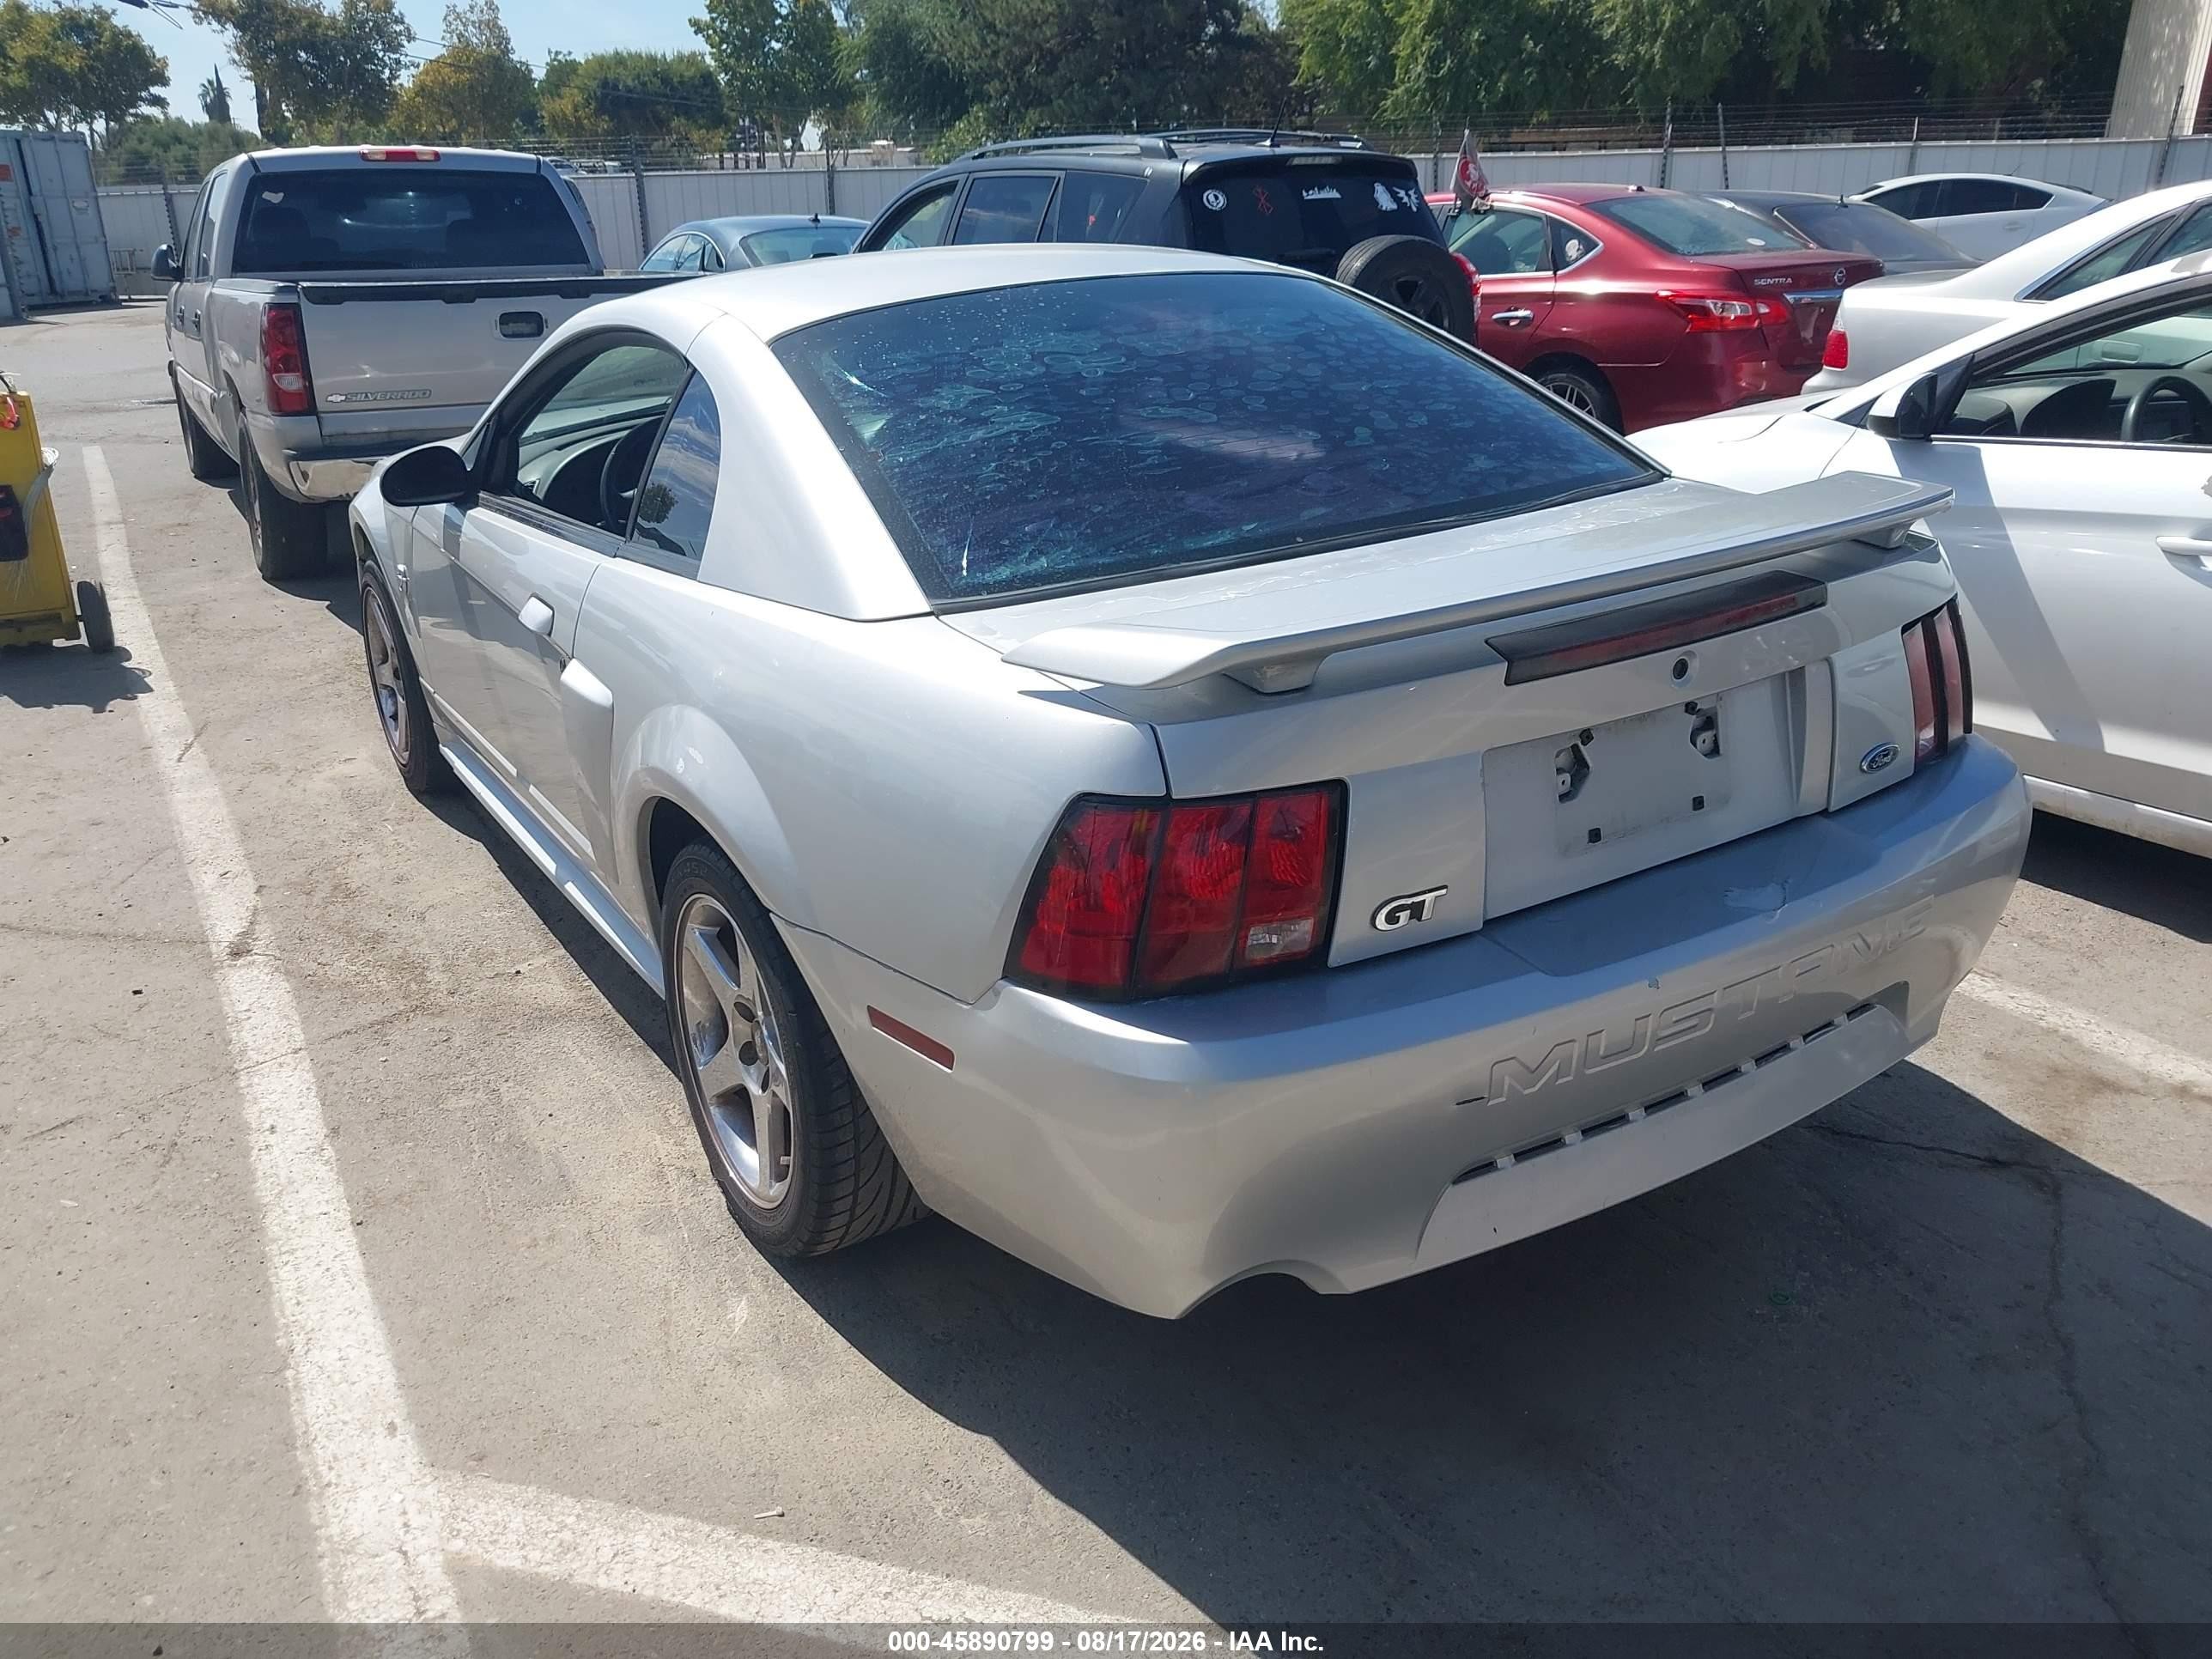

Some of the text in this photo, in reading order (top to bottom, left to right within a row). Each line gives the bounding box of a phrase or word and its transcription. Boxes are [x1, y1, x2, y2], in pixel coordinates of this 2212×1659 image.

[1753, 277, 1793, 286] SENTRA
[345, 389, 432, 403] SILVERADO
[1370, 884, 1449, 932] GT
